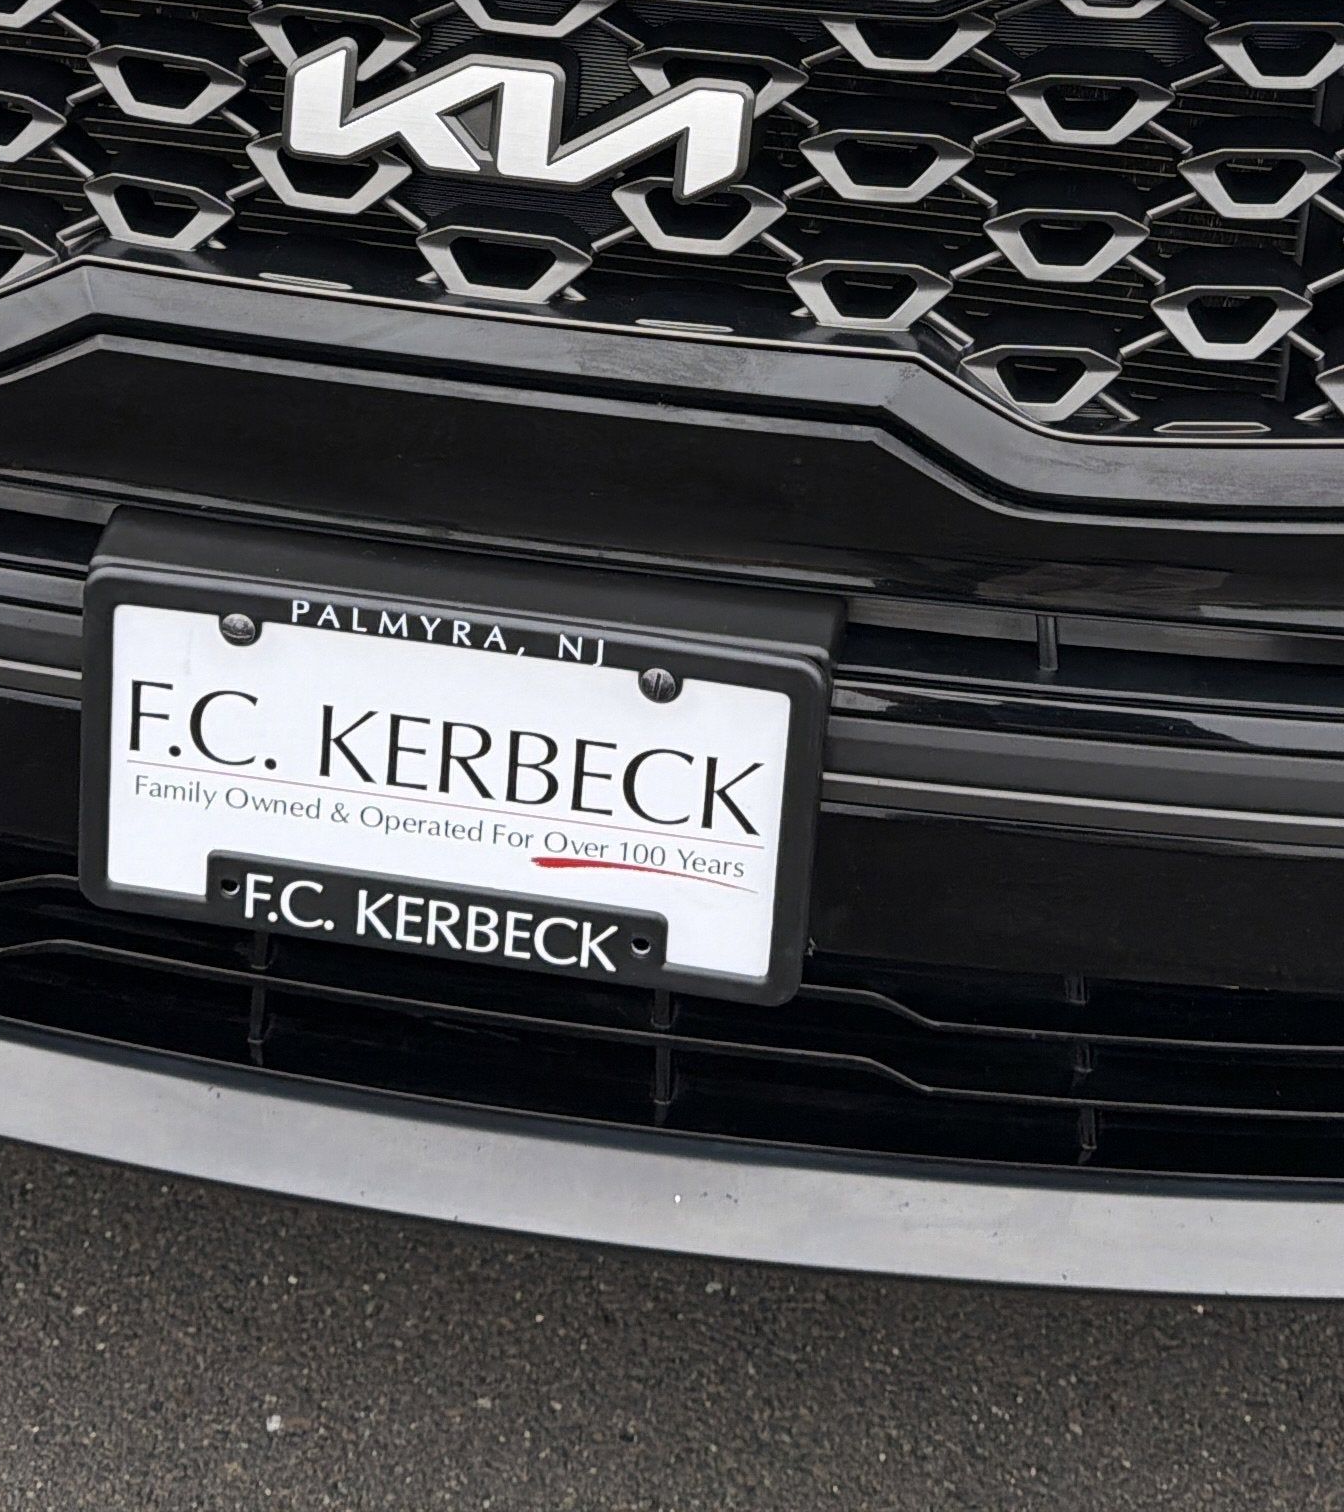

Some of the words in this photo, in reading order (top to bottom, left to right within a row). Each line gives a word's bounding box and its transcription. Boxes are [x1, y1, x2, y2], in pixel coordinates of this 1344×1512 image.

[291, 599, 525, 658] PALMYRA,
[558, 633, 605, 668] NJ
[128, 679, 278, 772] F.C.
[319, 704, 764, 837] KERBECK
[135, 774, 217, 809] Family
[225, 787, 321, 820] Owned
[330, 802, 351, 824] &
[359, 805, 484, 843] Operated
[492, 823, 534, 849] For
[544, 831, 610, 858] Over
[620, 841, 666, 867] 100
[676, 848, 745, 878] Years
[244, 872, 335, 931] F.C.
[355, 888, 618, 972] KERBECK
